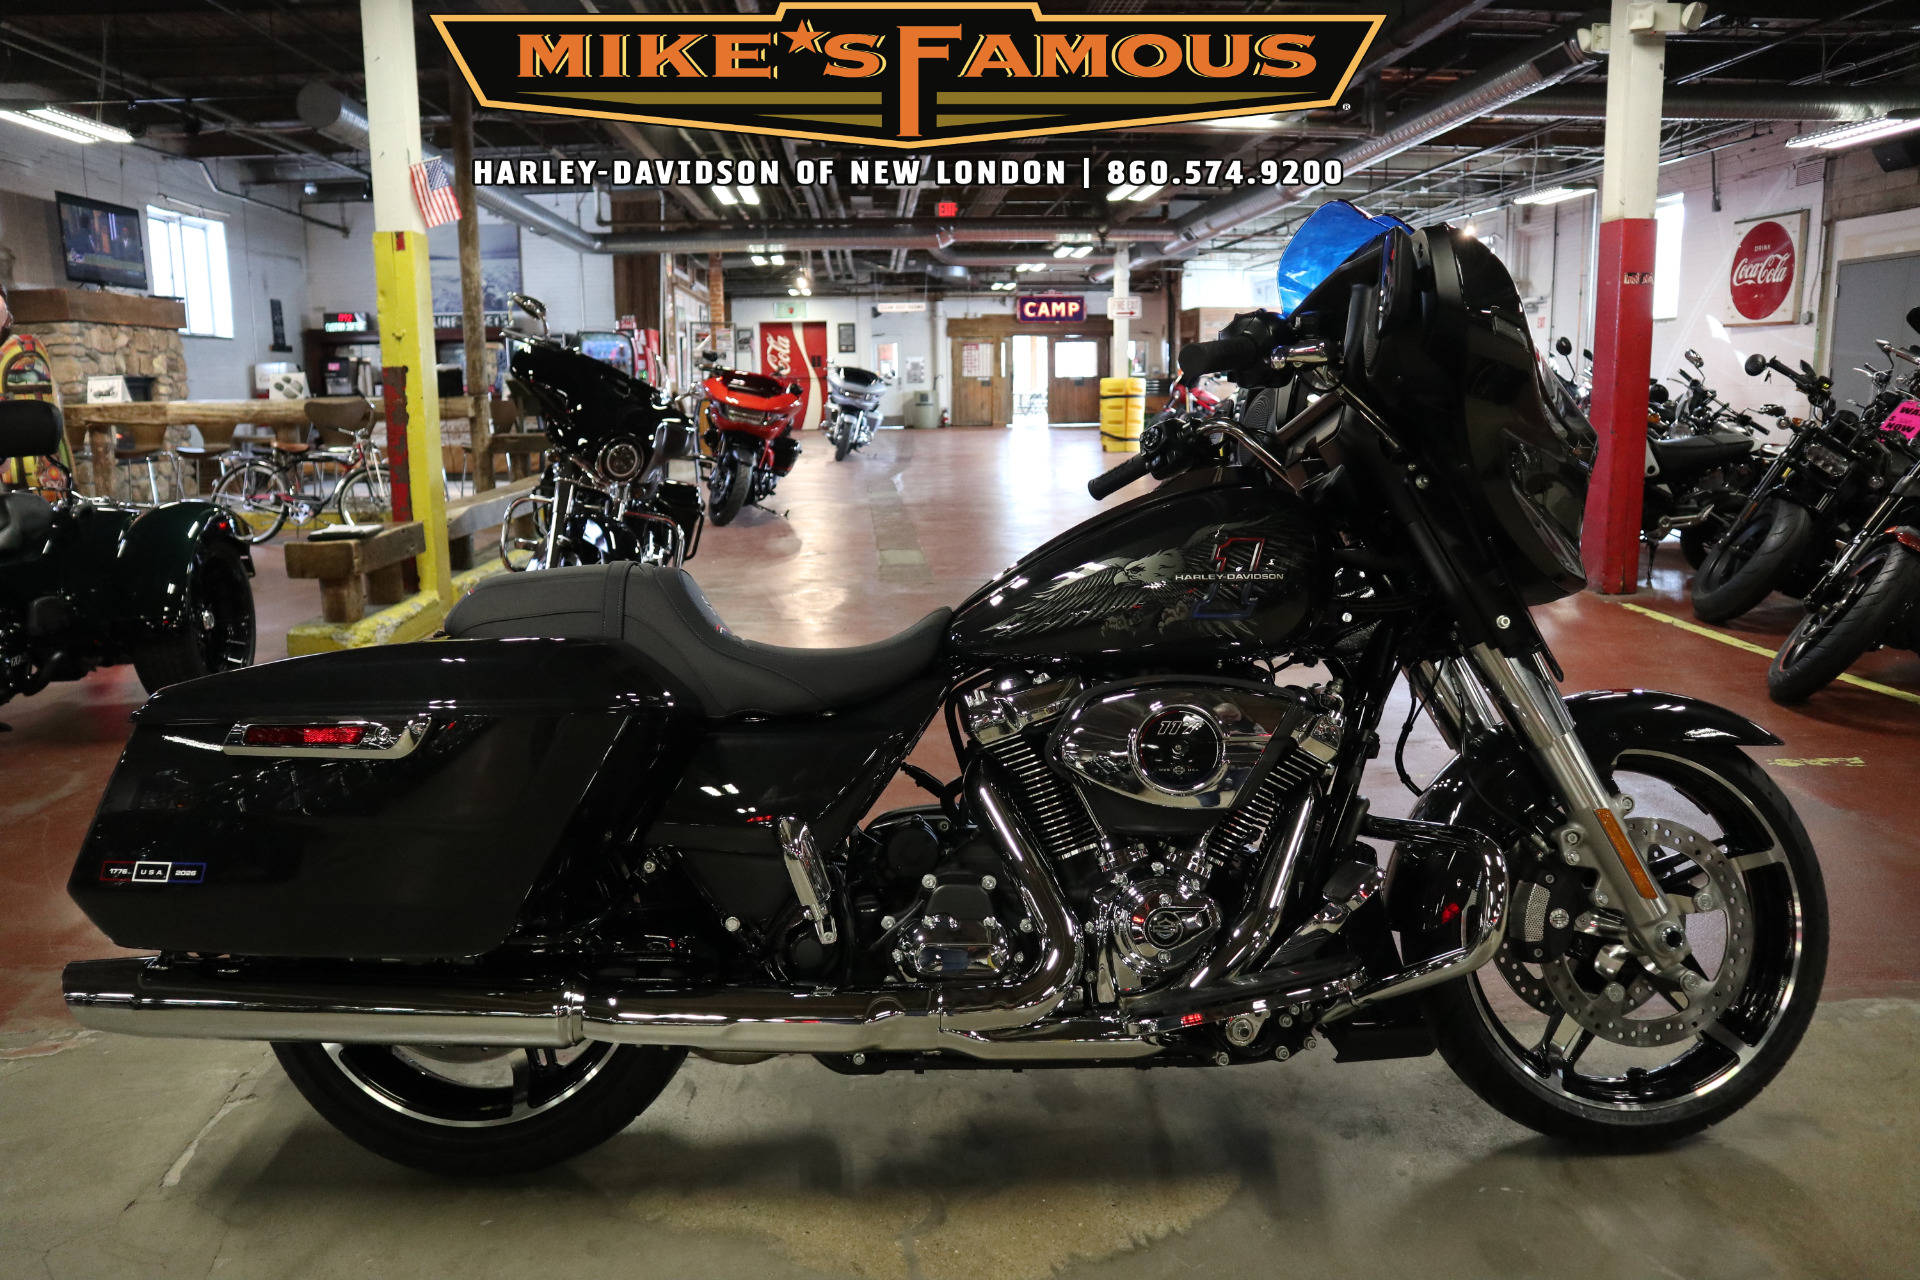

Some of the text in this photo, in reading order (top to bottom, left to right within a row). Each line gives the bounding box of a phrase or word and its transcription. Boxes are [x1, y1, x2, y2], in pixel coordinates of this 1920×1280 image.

[1754, 244, 1771, 252] DRINK
[1733, 252, 1791, 287] Coca-Cola
[1023, 301, 1081, 318] CAMP
[1899, 406, 1920, 418] WA
[1885, 422, 1916, 433] NOW
[1174, 572, 1285, 581] HARLEY-DAVIDSON
